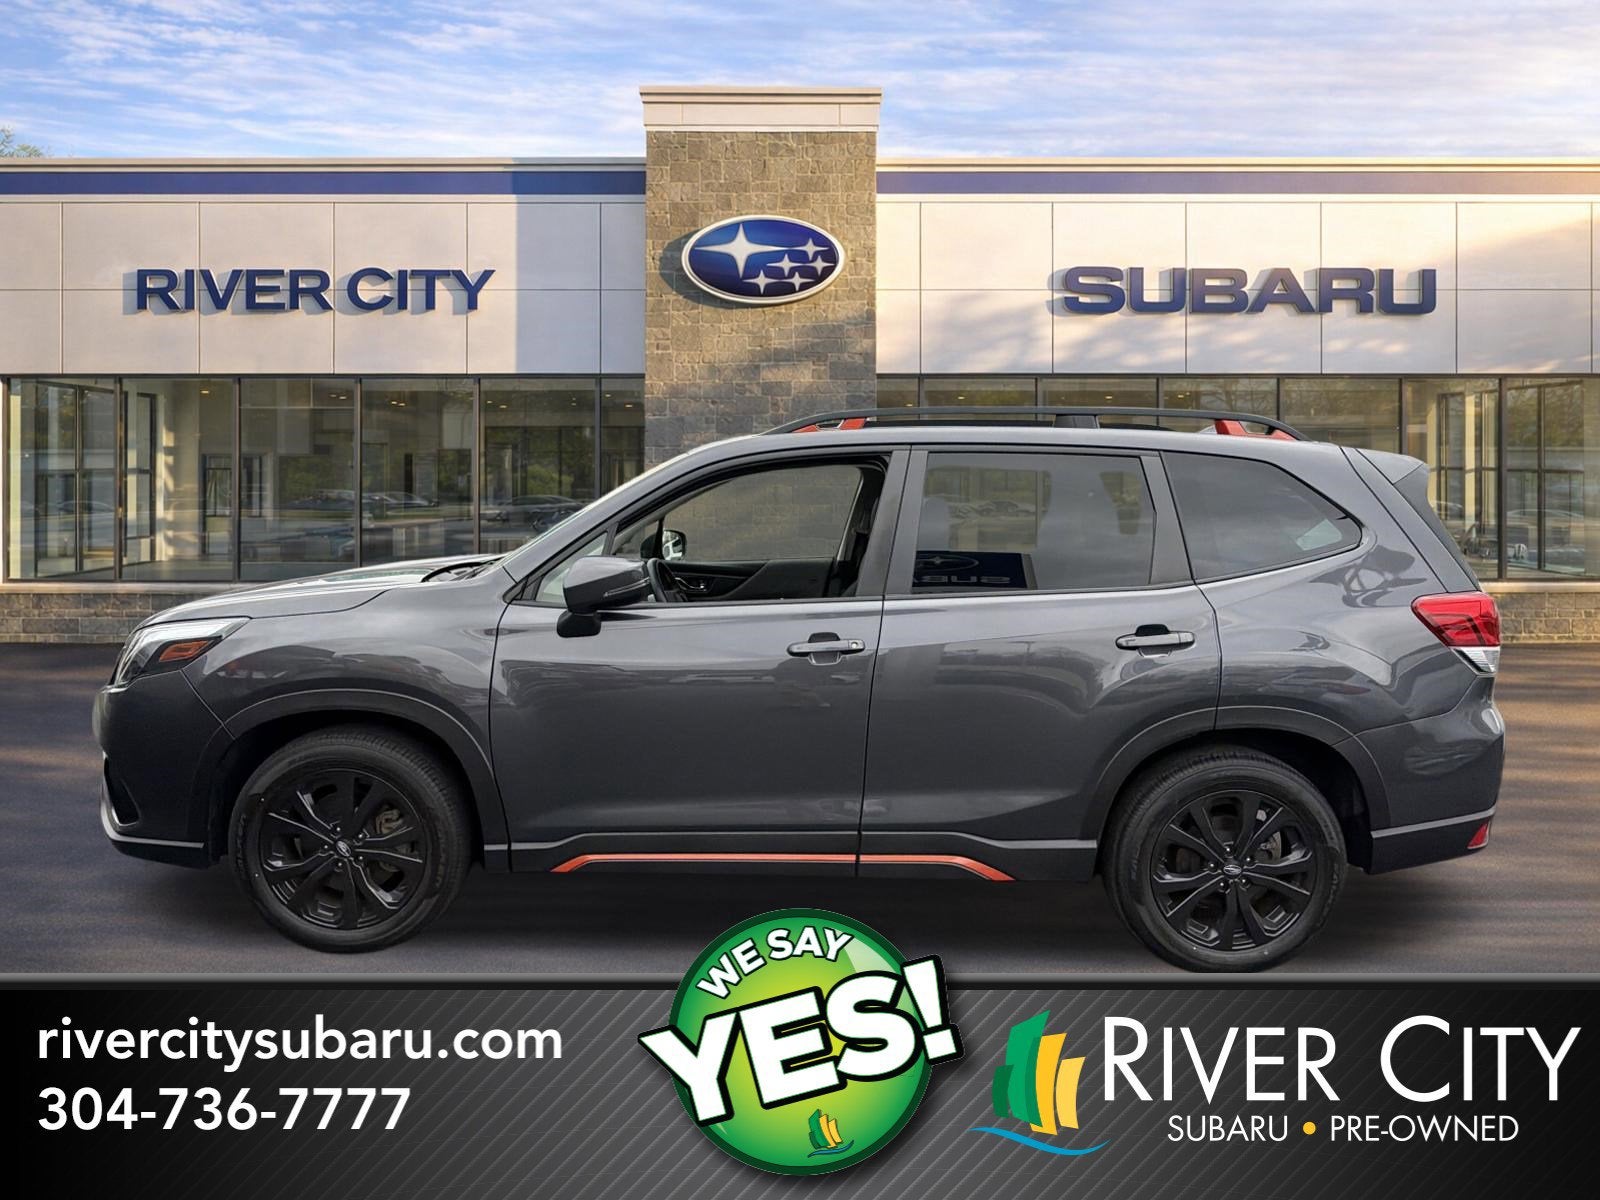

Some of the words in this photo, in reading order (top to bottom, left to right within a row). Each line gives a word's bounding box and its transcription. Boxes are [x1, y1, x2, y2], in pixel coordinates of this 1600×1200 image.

[136, 269, 333, 310] RIVER
[347, 267, 495, 310] CITY
[1064, 266, 1436, 314] SUBARU
